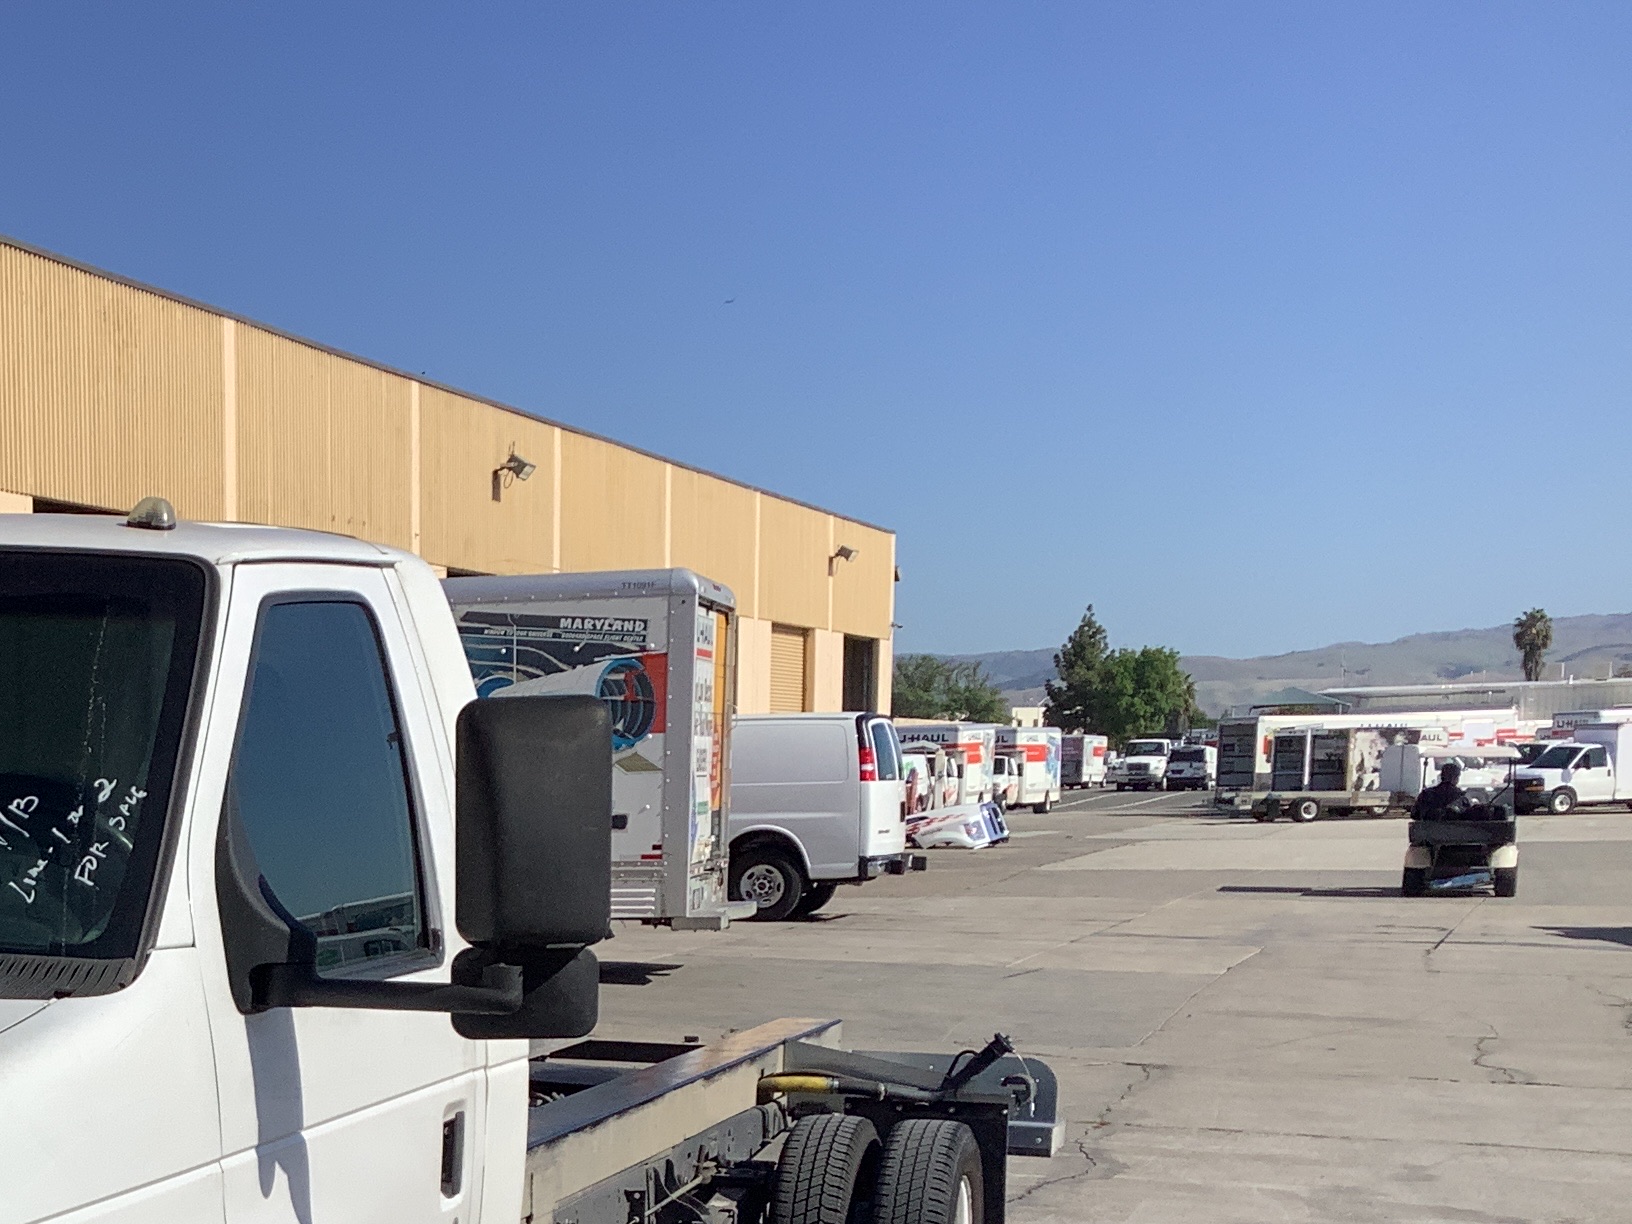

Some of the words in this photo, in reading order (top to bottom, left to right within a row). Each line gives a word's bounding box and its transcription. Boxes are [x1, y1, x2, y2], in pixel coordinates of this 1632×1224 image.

[559, 618, 645, 632] MARYLAND
[94, 778, 118, 803] 2
[74, 841, 109, 886] FOR
[108, 786, 148, 830] SALE
